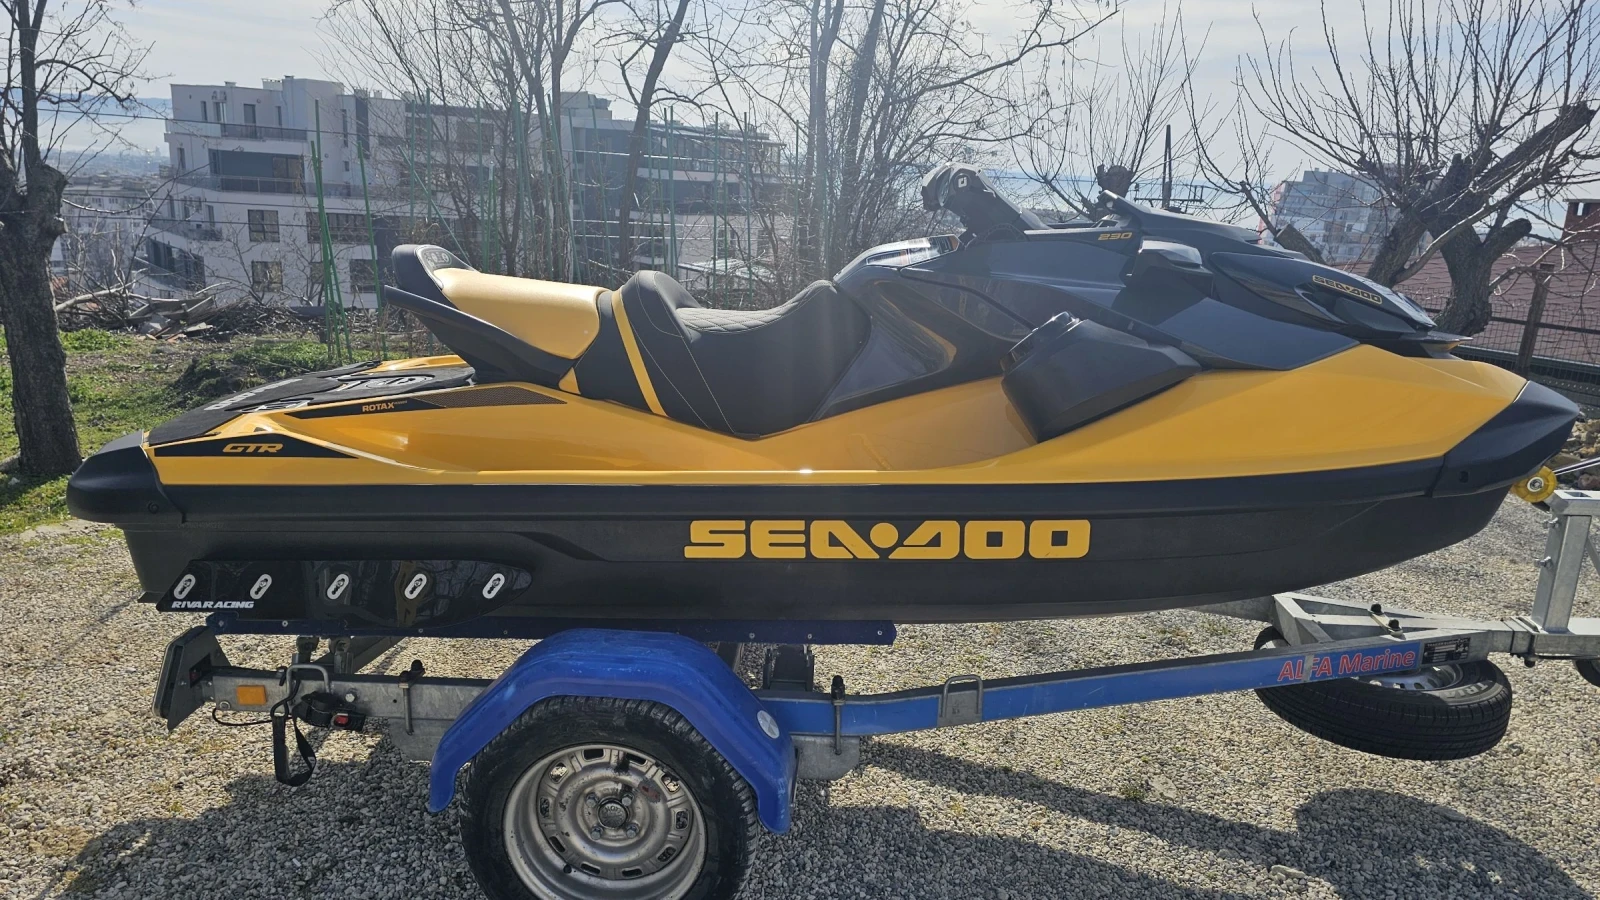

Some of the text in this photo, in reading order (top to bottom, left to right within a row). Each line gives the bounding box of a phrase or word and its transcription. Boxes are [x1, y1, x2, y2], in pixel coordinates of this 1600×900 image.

[1097, 232, 1133, 240] 230
[362, 402, 395, 412] ROTAX
[222, 442, 284, 453] GTR
[1338, 648, 1417, 675] Marine
